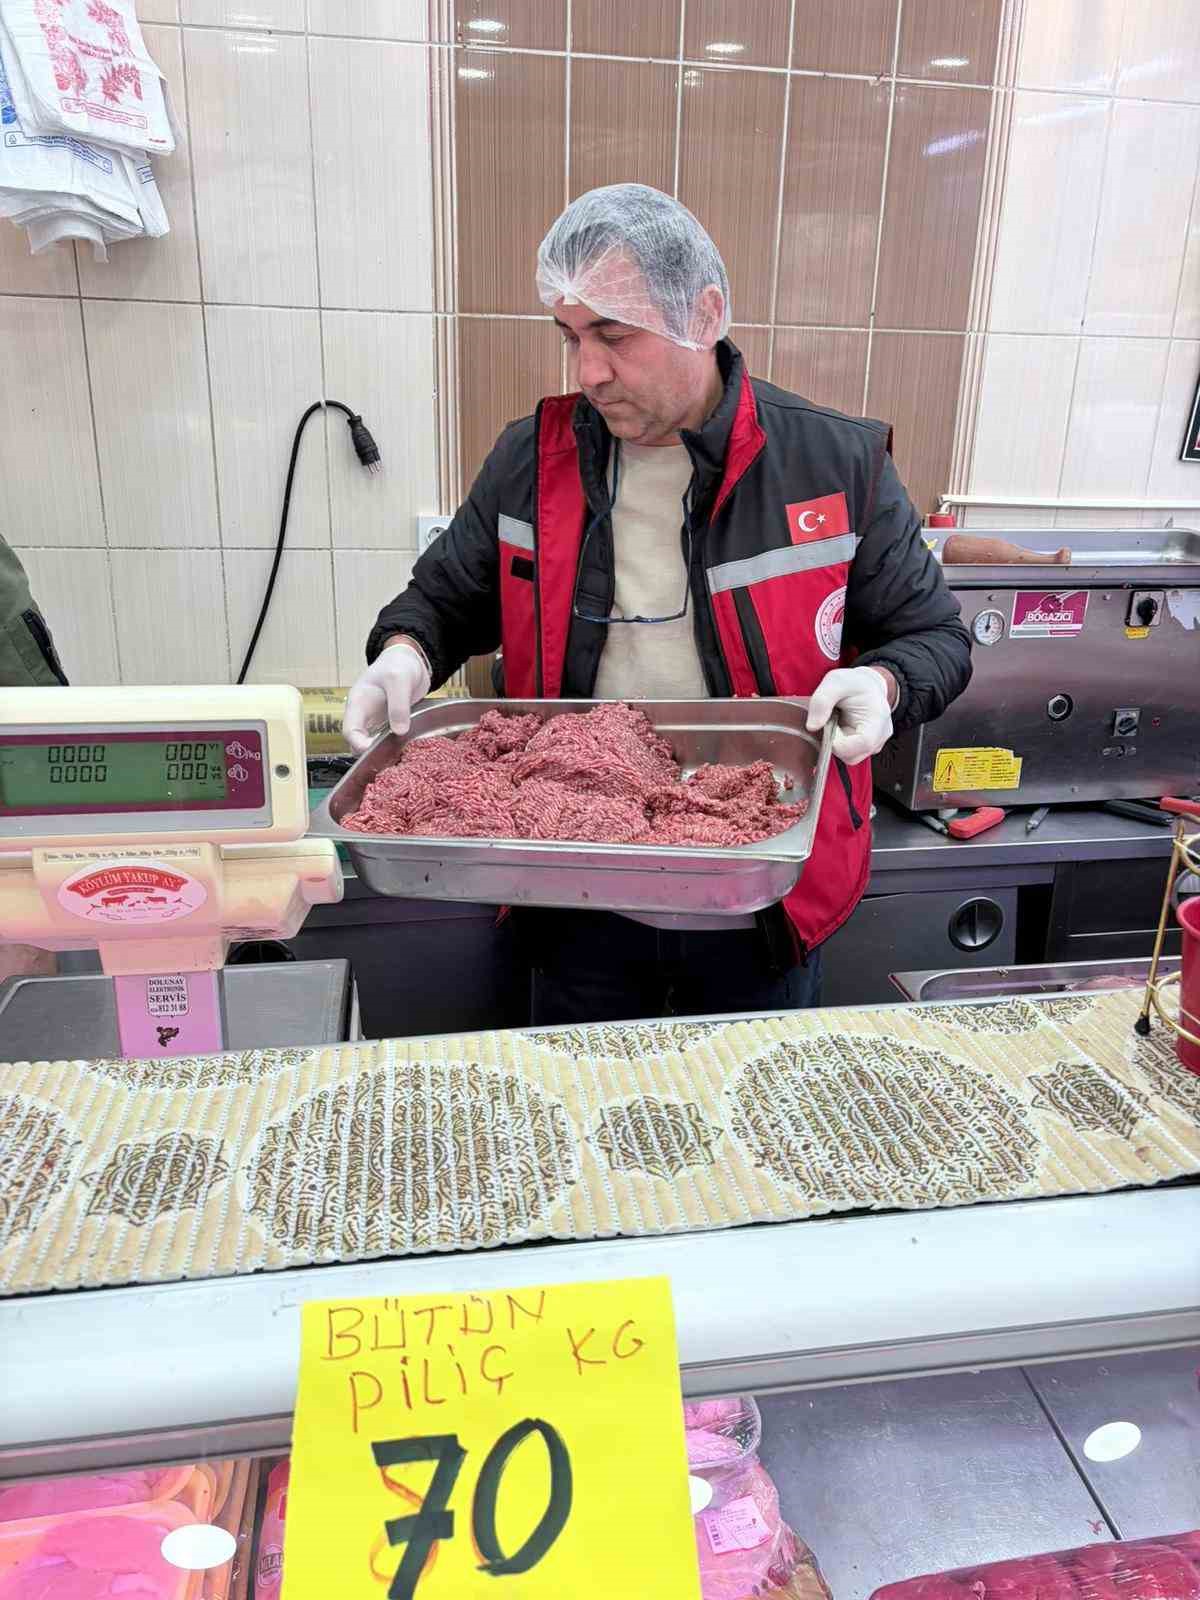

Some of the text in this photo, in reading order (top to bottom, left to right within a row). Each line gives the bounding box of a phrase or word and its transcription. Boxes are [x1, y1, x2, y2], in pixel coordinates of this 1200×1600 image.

[48, 745, 105, 763] 0000
[50, 765, 107, 783] 0000
[149, 993, 186, 1003] SERVİS
[320, 1290, 545, 1360] BÜTÜN
[349, 1320, 644, 1433] PİLİÇ KG
[370, 1417, 573, 1600] 70
